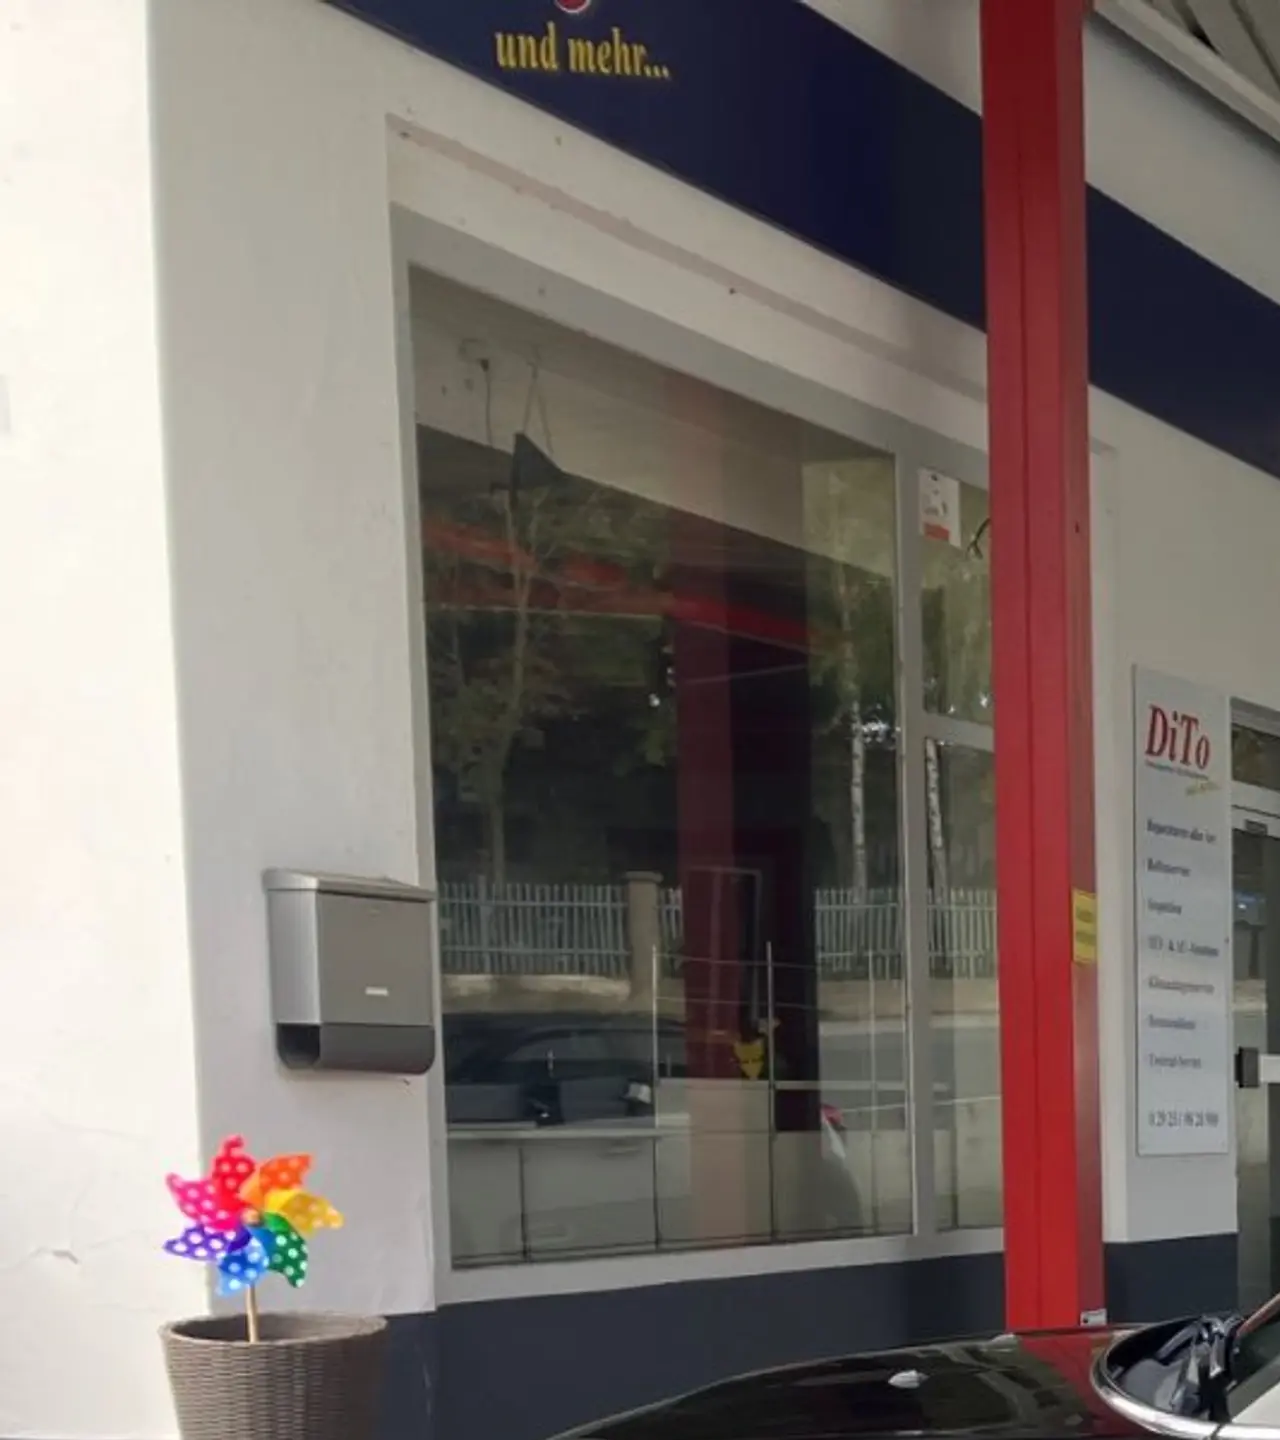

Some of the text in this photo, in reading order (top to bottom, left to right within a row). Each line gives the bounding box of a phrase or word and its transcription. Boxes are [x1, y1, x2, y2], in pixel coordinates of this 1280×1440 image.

[495, 20, 670, 78] und mehr...
[1144, 703, 1210, 769] DiTo
